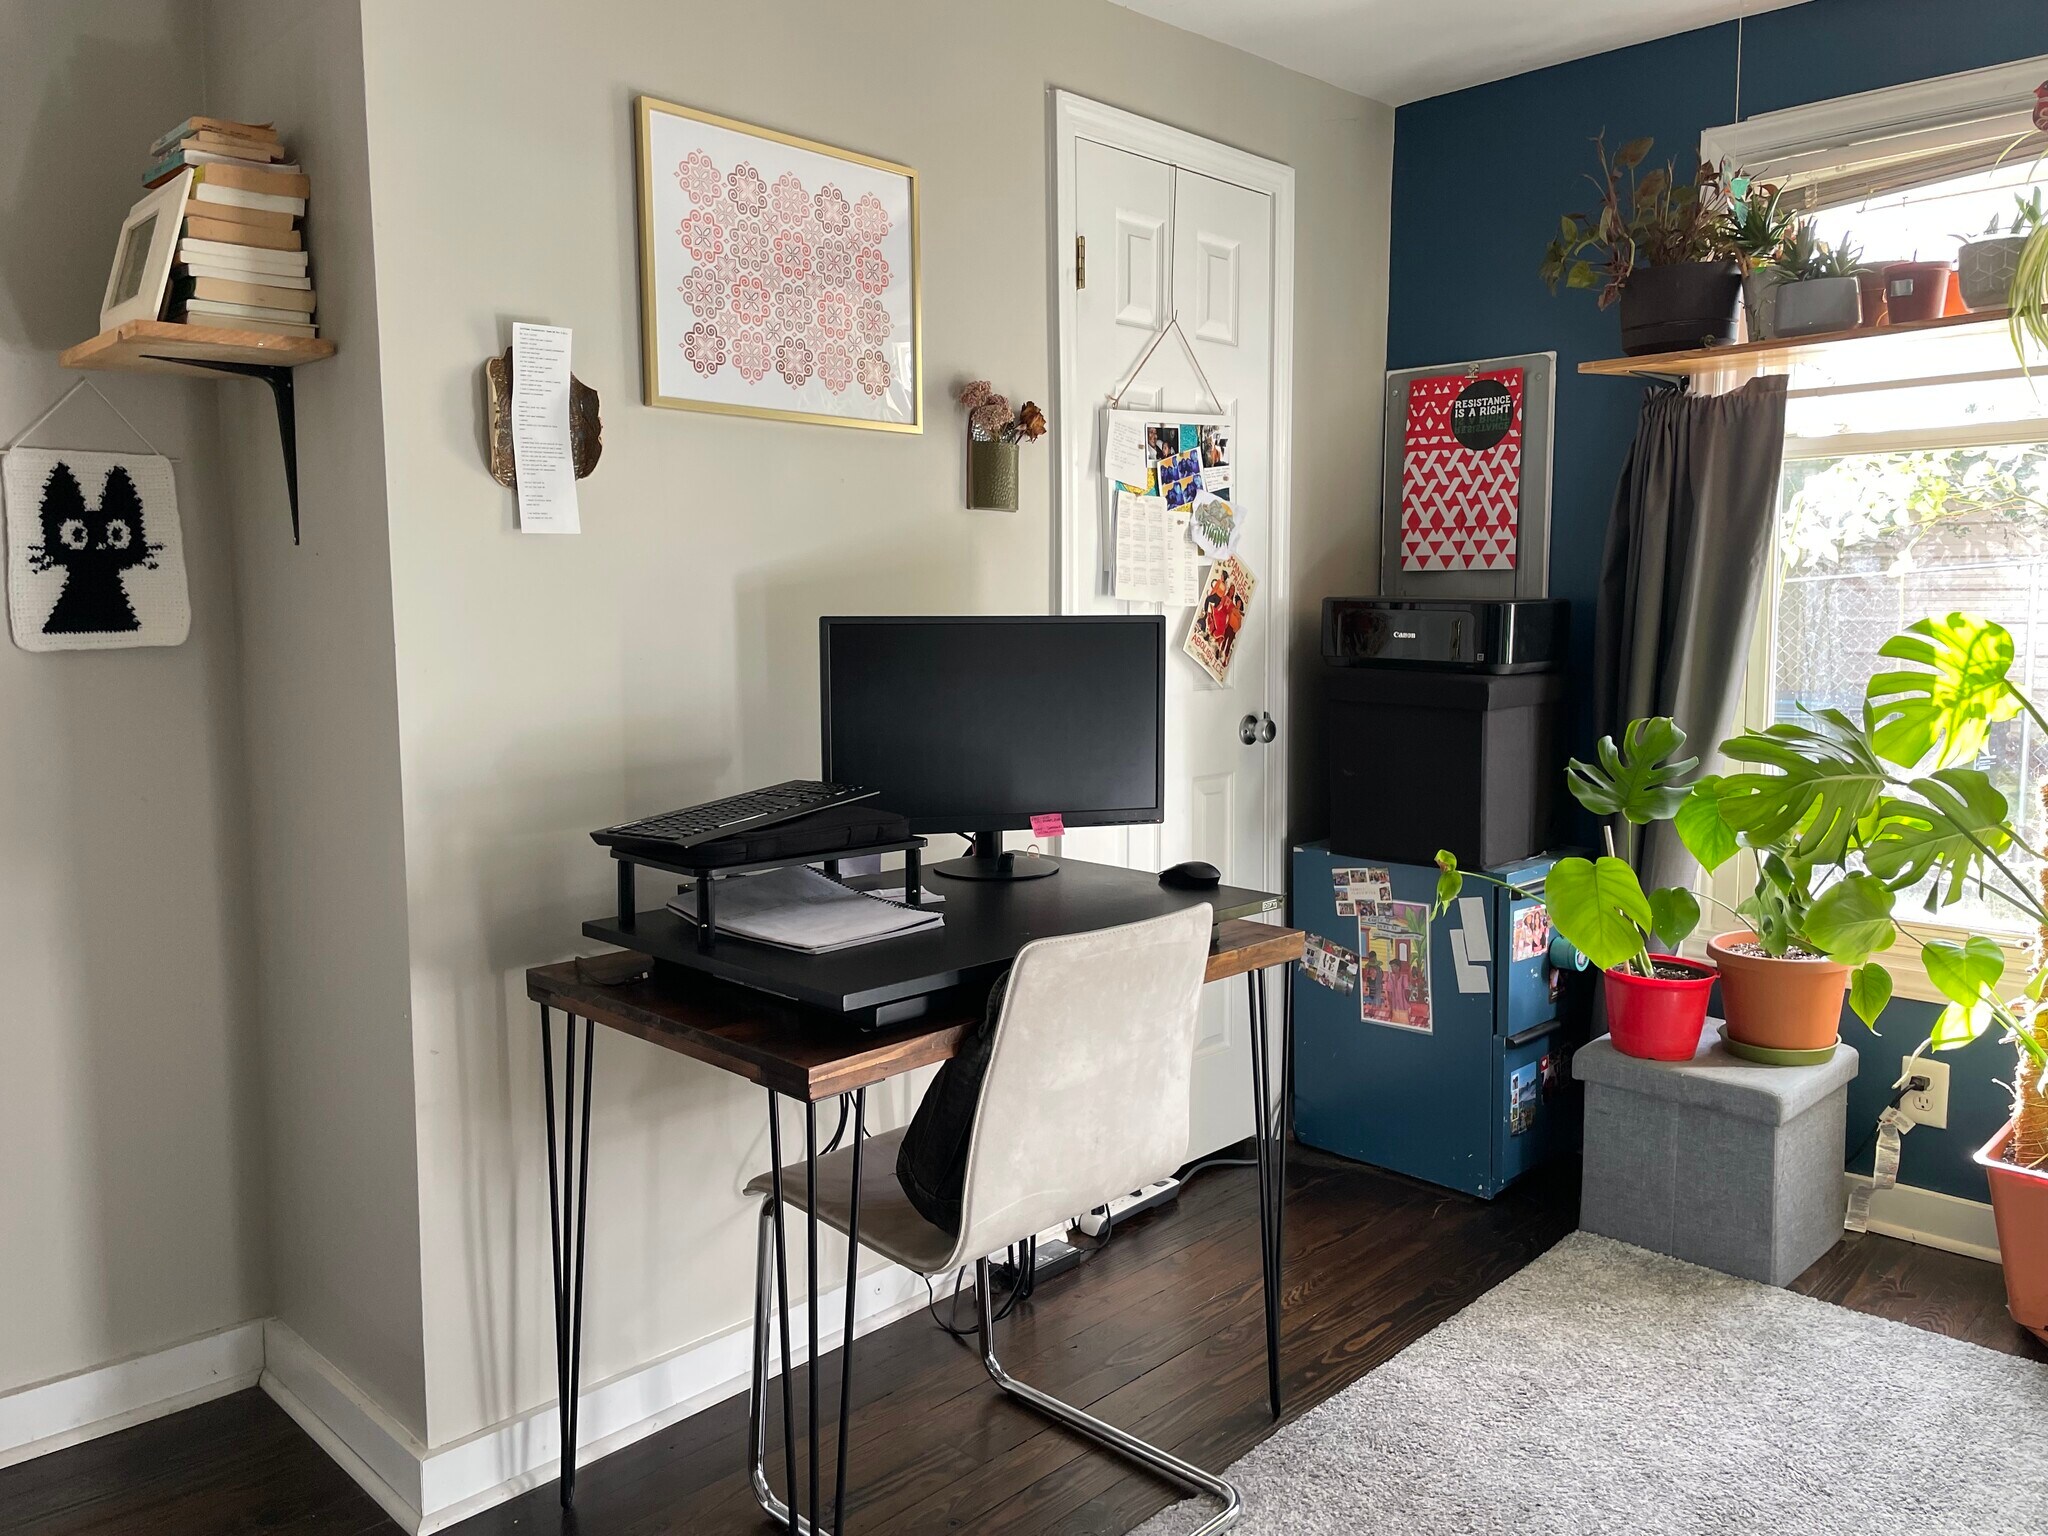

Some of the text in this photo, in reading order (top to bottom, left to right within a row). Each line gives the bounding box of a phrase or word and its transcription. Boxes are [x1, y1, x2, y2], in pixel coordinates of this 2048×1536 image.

[1455, 395, 1511, 408] RESISTANCE
[1455, 404, 1510, 418] IS A RIGHT
[1230, 569, 1250, 605] PRISONS
[1191, 633, 1214, 663] ABOLISH
[1212, 660, 1224, 677] ICE
